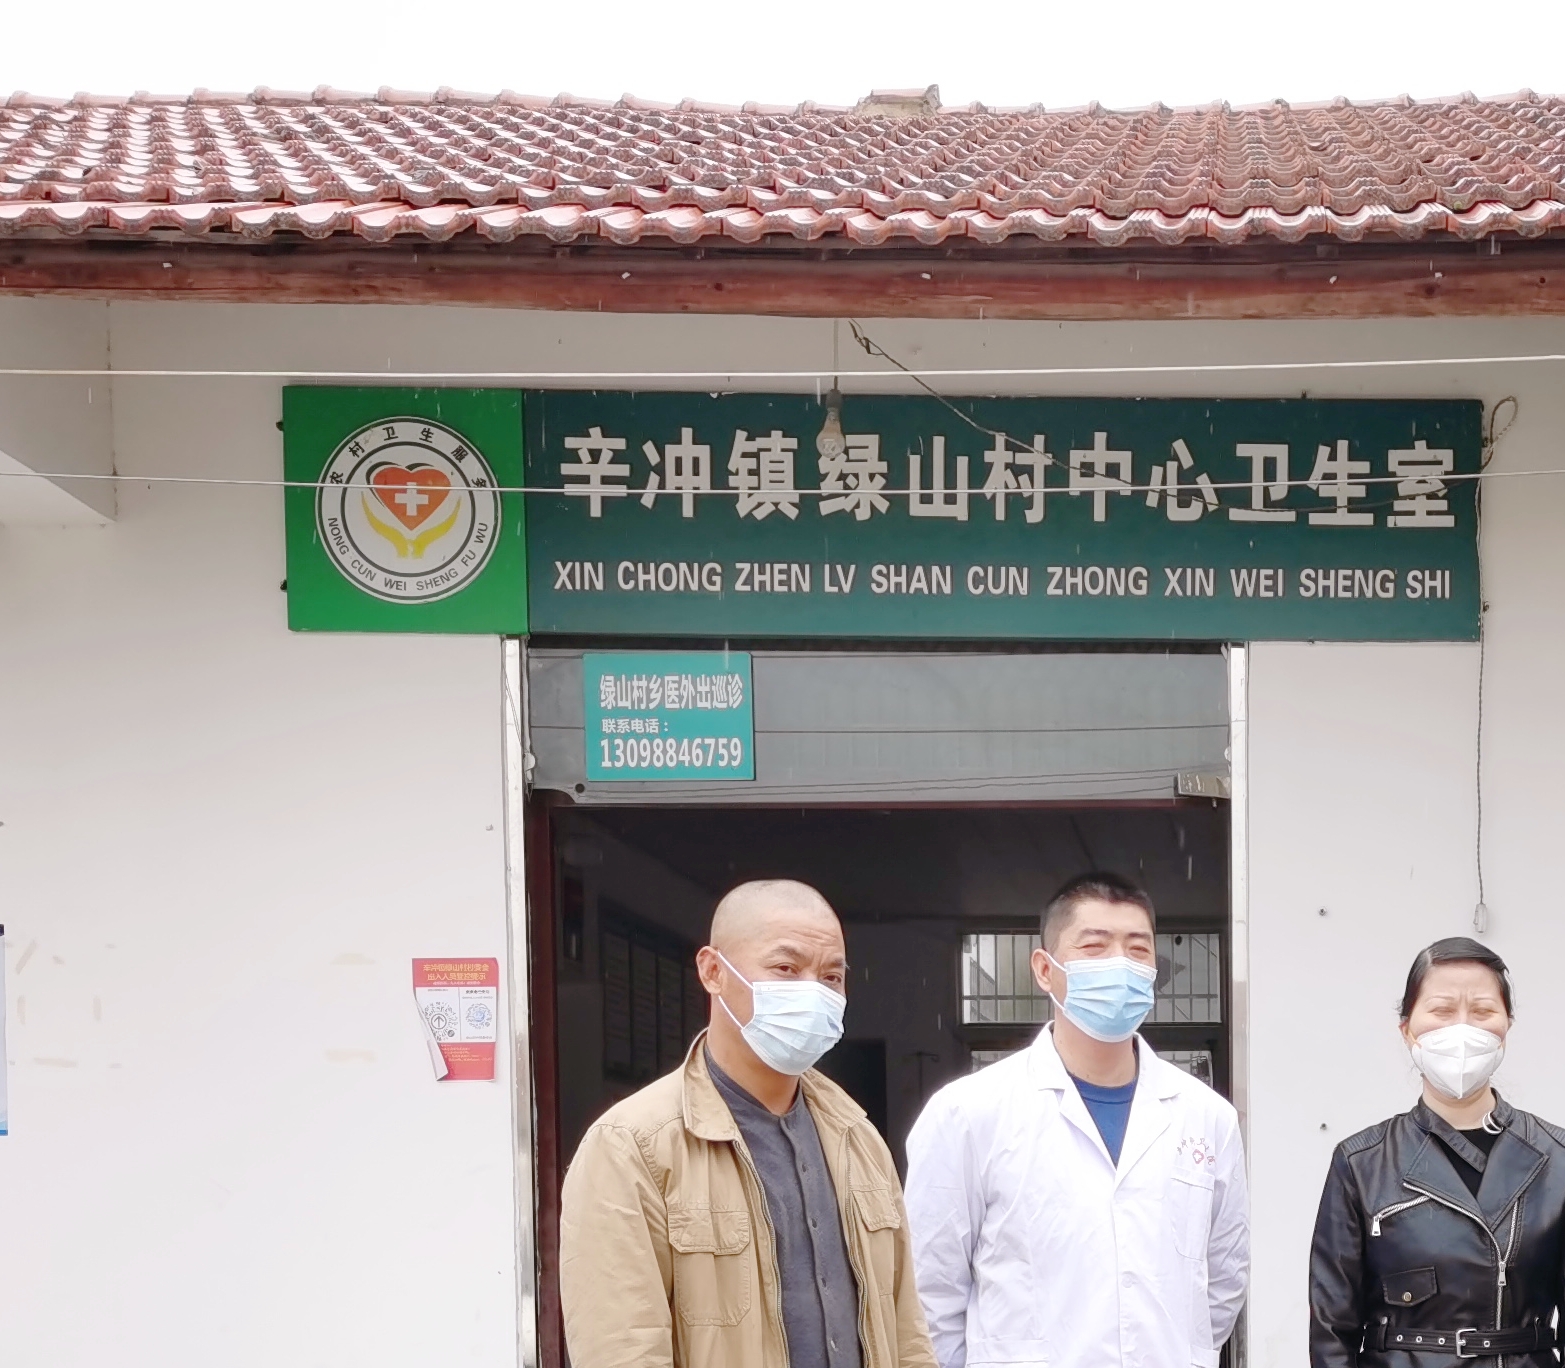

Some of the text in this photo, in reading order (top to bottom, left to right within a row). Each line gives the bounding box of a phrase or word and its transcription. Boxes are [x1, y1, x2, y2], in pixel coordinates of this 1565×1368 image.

[562, 428, 1456, 528] 辛冲镇绿山村中心卫生室
[327, 517, 488, 591] NONG CUN WEI SHENG FU WU
[554, 561, 1451, 600] XIN CHONG ZHEN LV SHAN CUN ZHONG XIN WEI SHENG SHI
[600, 674, 743, 710] 绿山村乡医外出巡诊
[602, 718, 669, 734] 联系电话：
[600, 737, 742, 767] 13098846759
